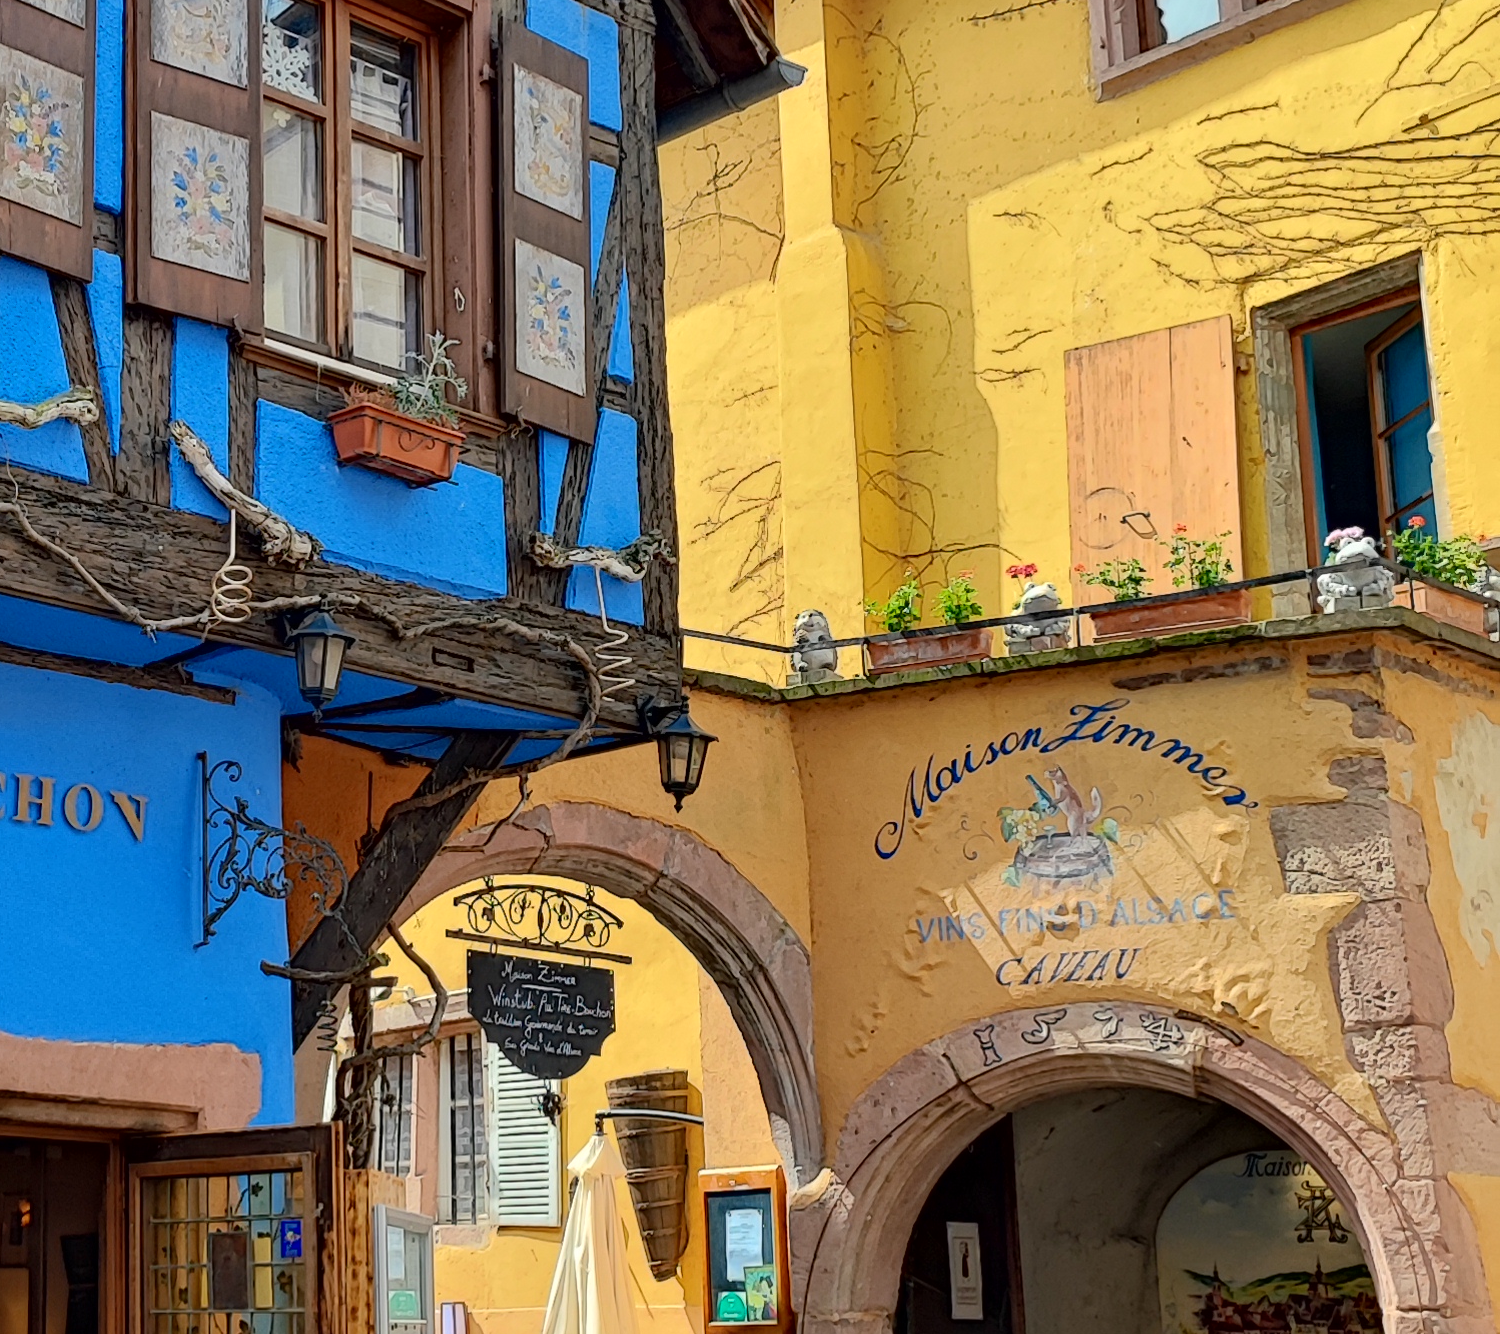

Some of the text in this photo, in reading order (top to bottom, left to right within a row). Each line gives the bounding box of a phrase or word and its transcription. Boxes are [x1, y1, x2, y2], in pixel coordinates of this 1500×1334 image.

[874, 698, 1260, 860] Maison Zimmer
[915, 913, 987, 943] VINS
[1000, 904, 1068, 935] FINS
[995, 947, 1143, 987] CAVEAU
